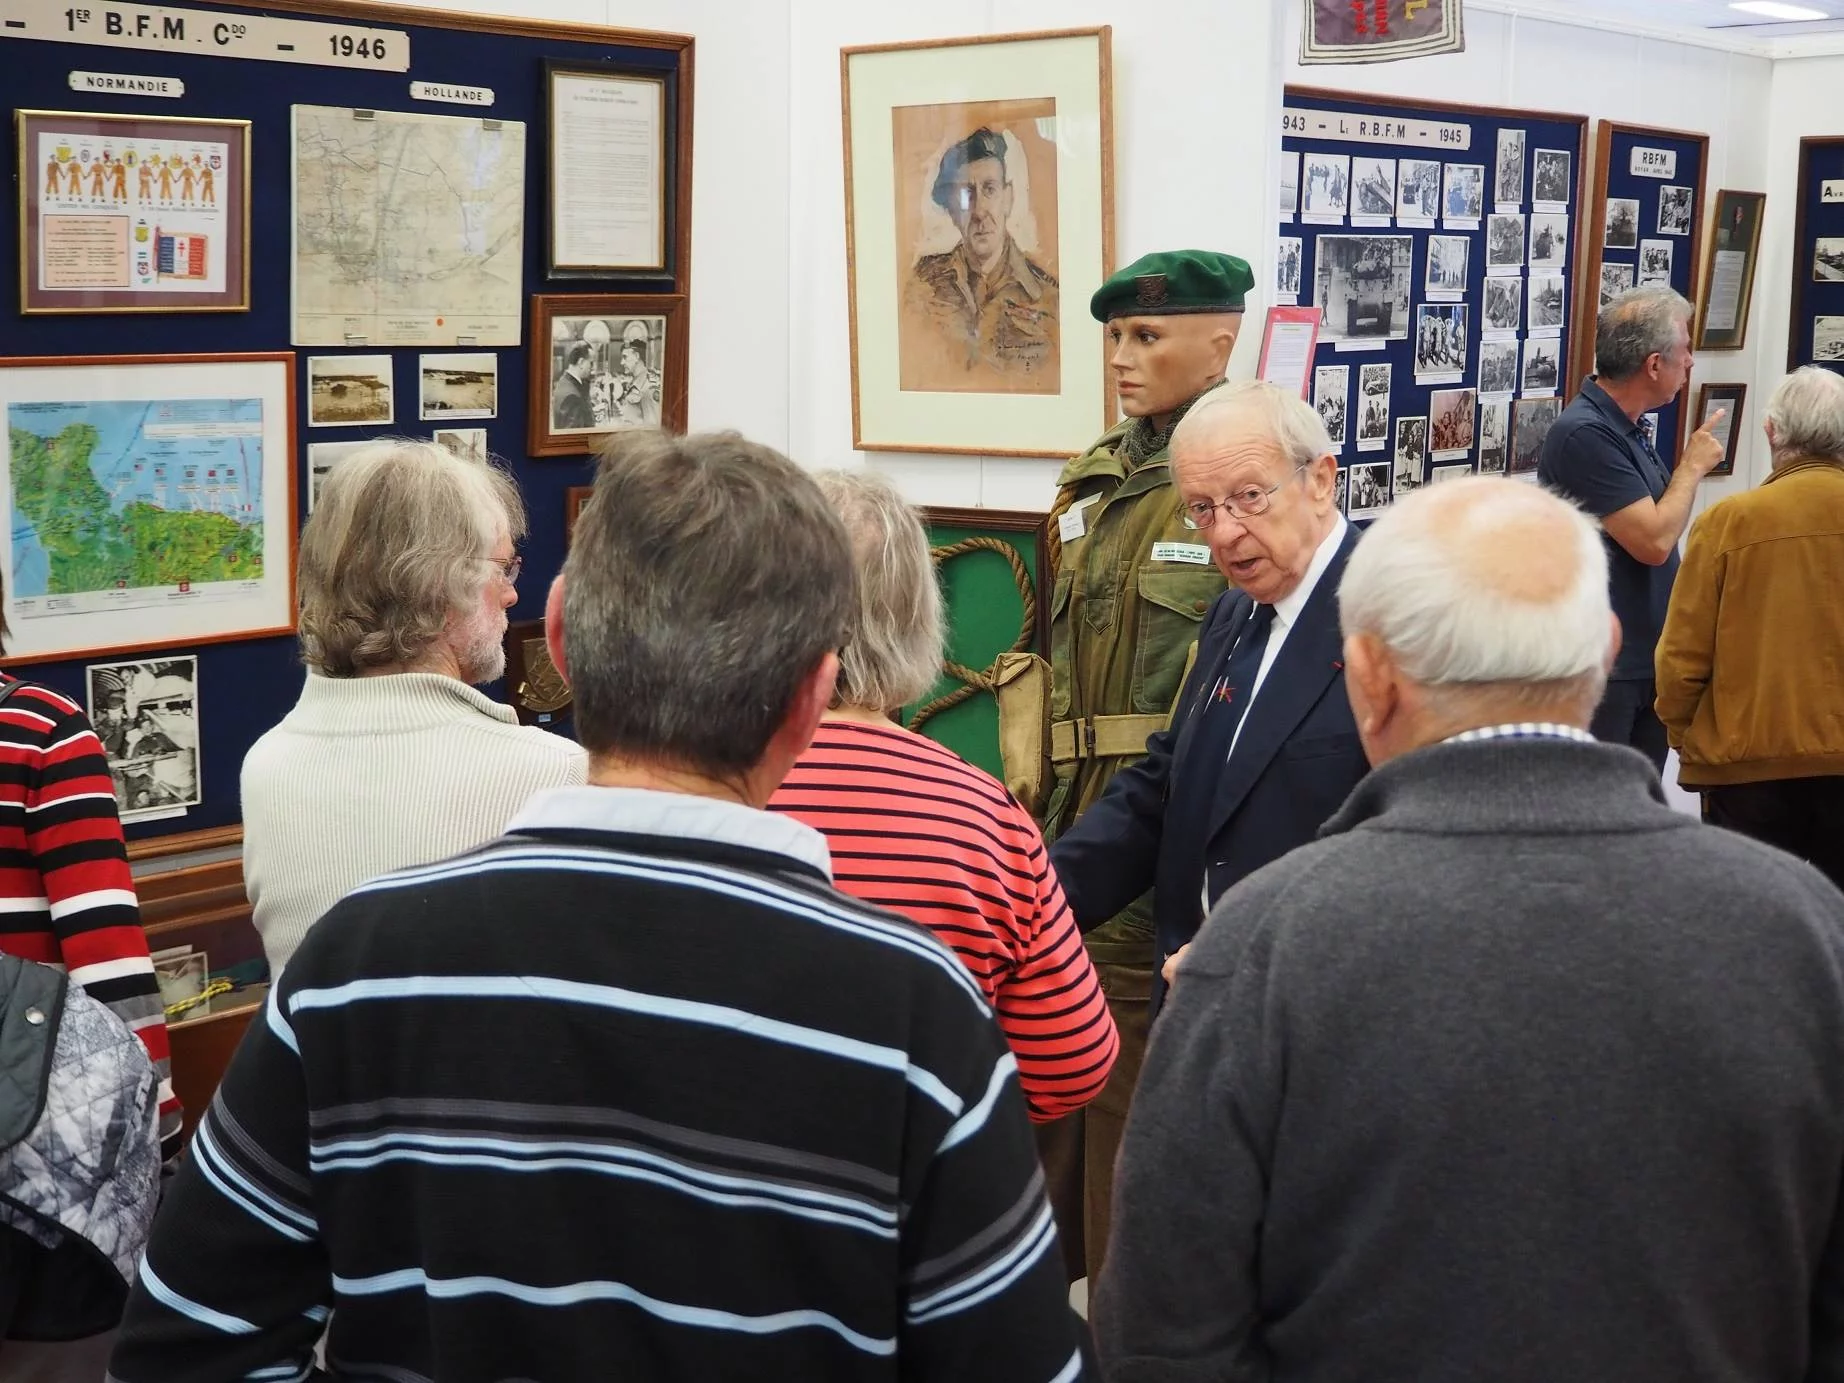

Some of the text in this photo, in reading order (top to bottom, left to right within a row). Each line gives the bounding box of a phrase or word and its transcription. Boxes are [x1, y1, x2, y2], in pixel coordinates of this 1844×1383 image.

[329, 34, 387, 60] 1946
[86, 76, 169, 93] NORMANDIE
[423, 86, 484, 102] HOLLANDE
[1282, 114, 1306, 132] 943
[1359, 121, 1406, 140] R.B.F.M
[1438, 127, 1463, 144] 1945
[1642, 151, 1667, 166] RBFM
